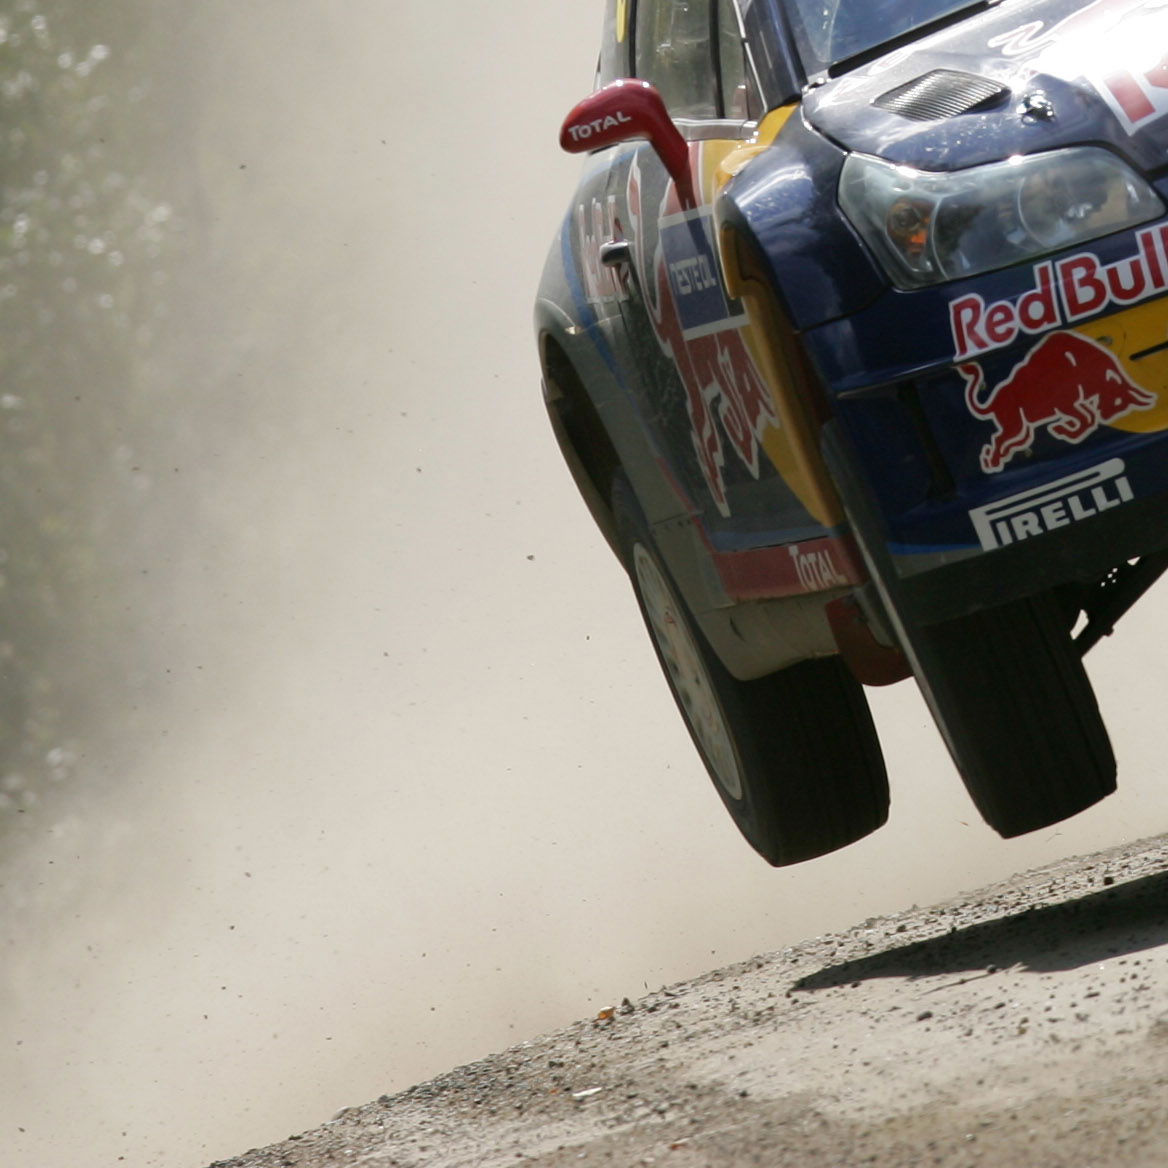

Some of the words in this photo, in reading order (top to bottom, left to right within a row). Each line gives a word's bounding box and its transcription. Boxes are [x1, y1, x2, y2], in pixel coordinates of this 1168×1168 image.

[568, 111, 631, 142] TOTAL
[950, 259, 1063, 362] Red
[968, 457, 1134, 552] PIRELLI
[788, 544, 848, 592] TOTAL
